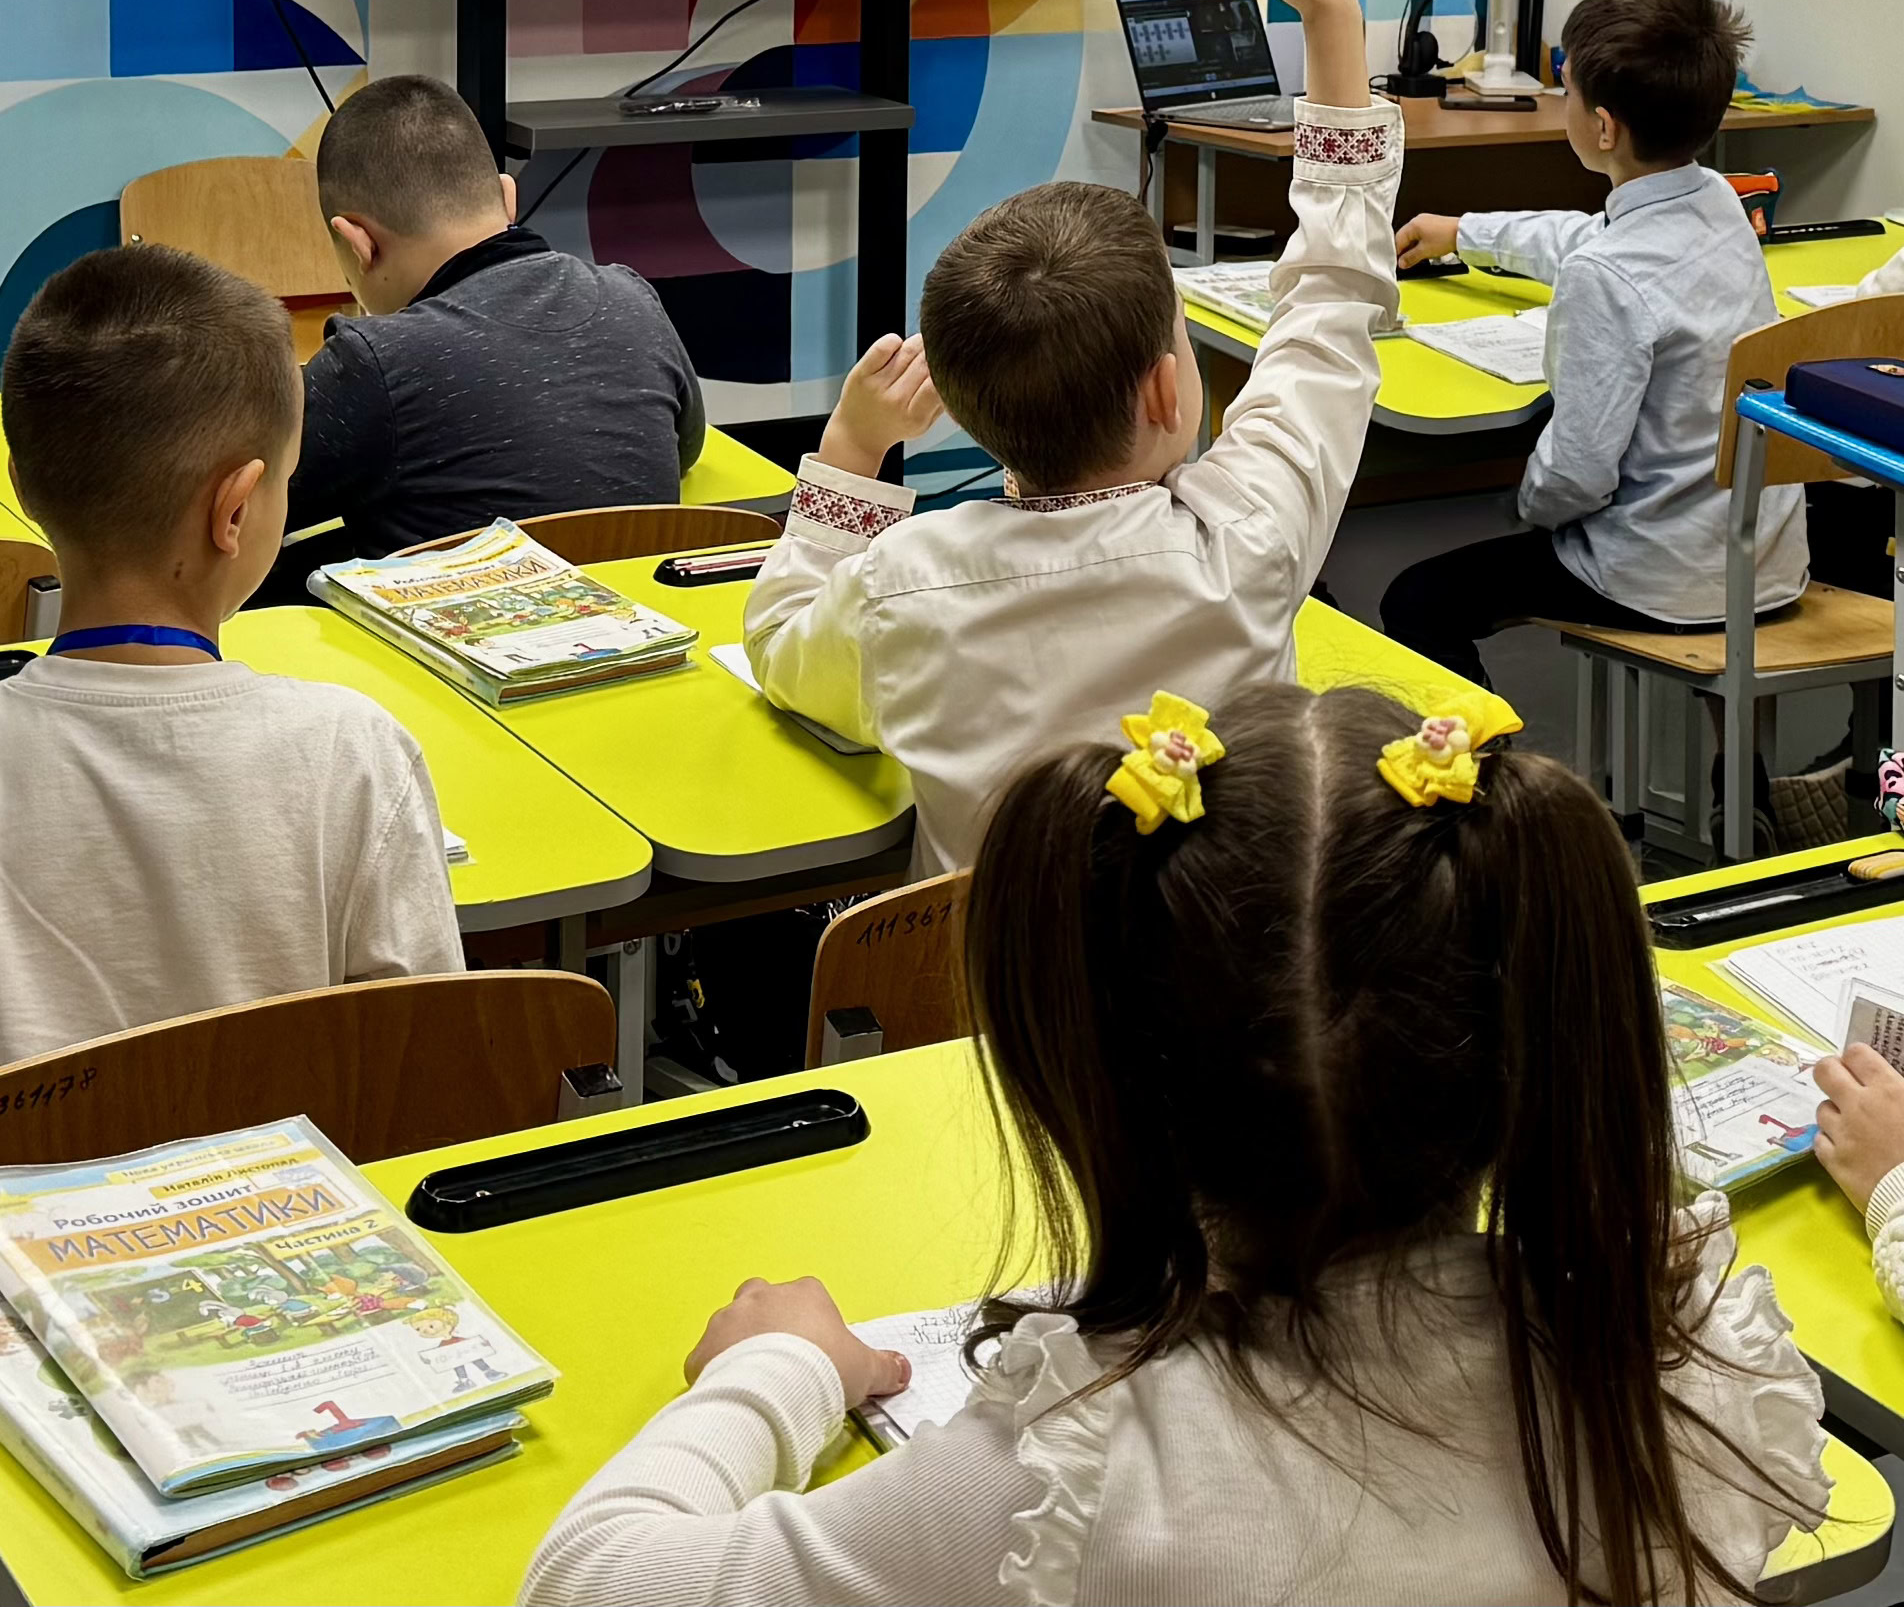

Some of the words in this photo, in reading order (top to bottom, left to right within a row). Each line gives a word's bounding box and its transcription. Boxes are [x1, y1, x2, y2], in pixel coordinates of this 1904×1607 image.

[396, 559, 548, 599] МАТЕМАТИКИ
[226, 1158, 300, 1178] Листопад
[47, 1188, 338, 1264] МАТЕМАТИКИ
[52, 1202, 170, 1231] Робочий
[175, 1184, 254, 1211] зошит
[274, 1225, 361, 1251] Частина
[366, 1219, 380, 1230] 2
